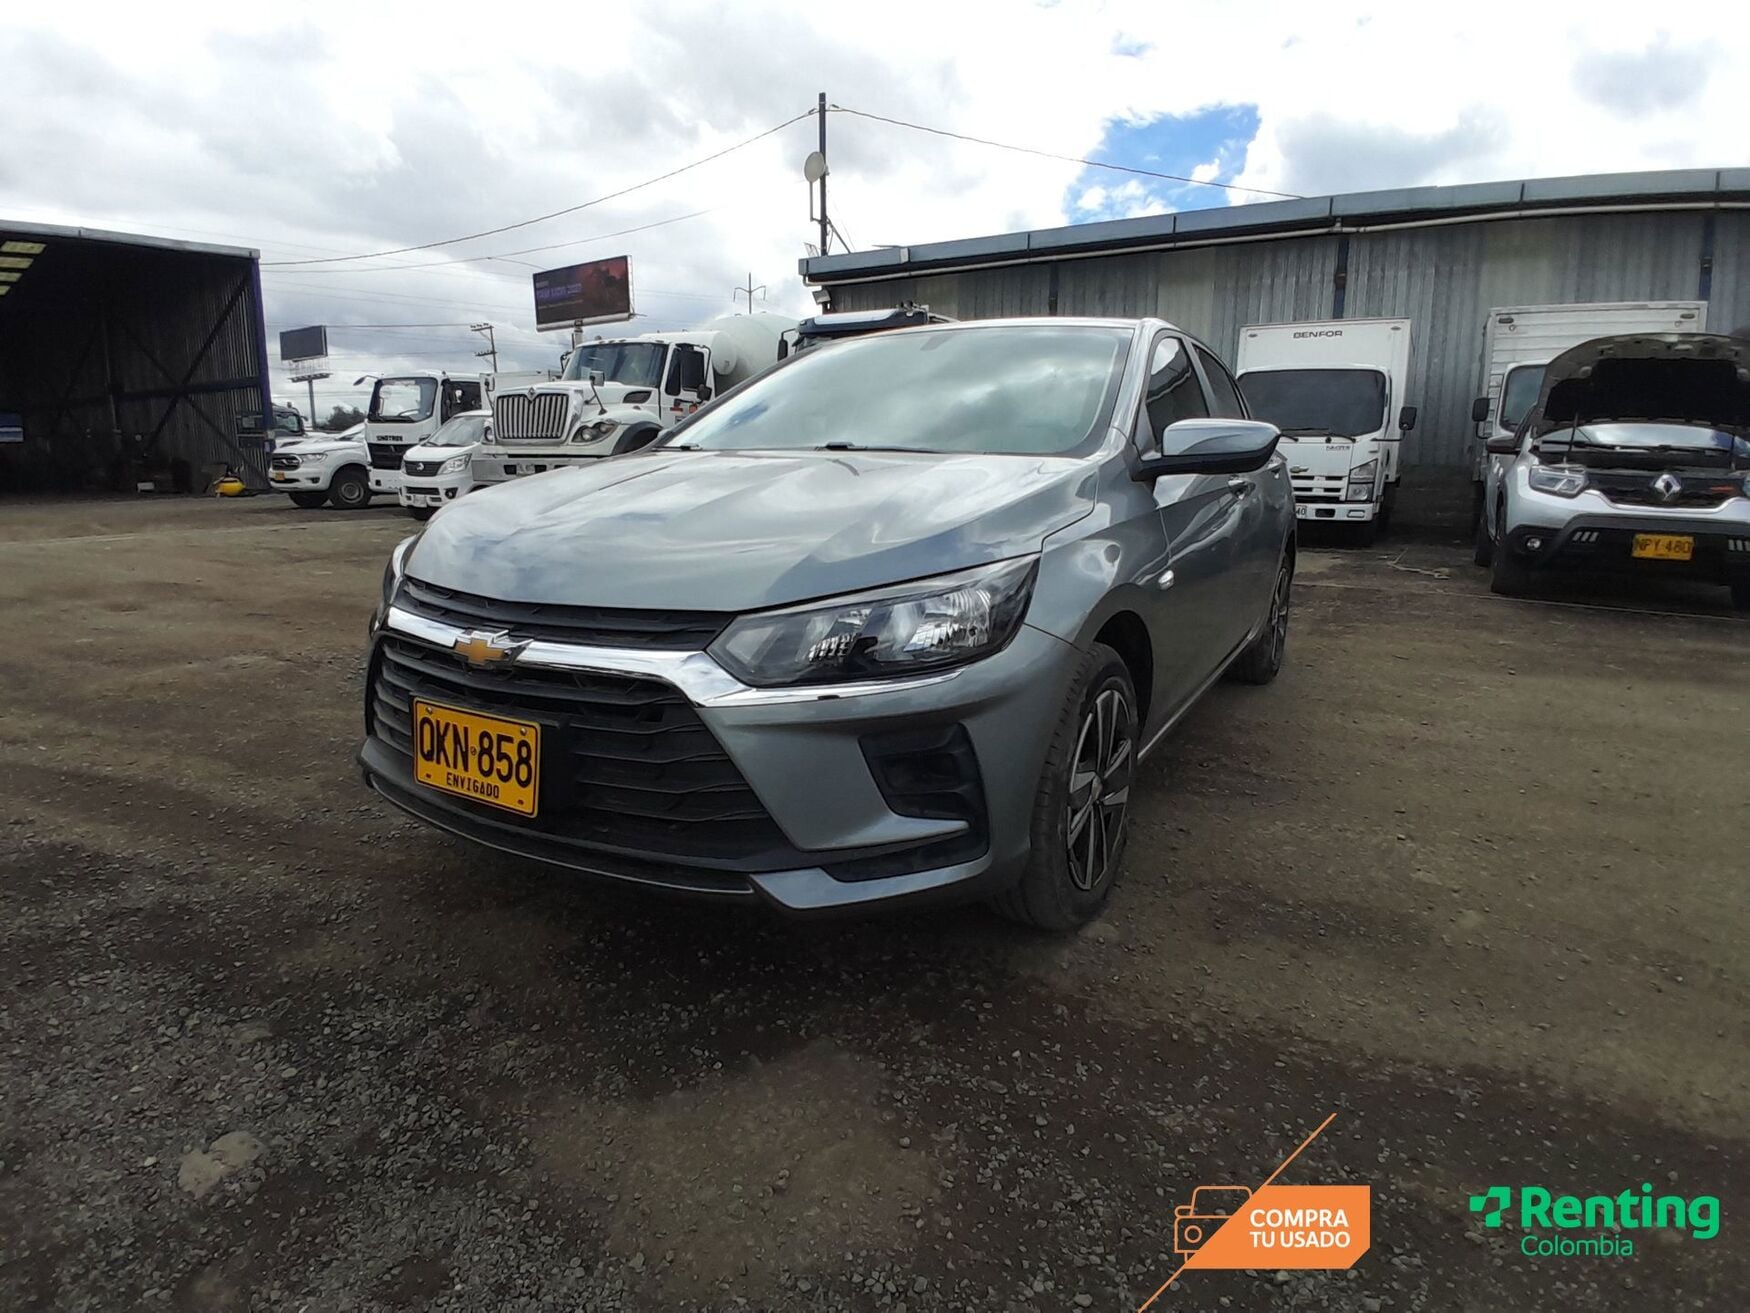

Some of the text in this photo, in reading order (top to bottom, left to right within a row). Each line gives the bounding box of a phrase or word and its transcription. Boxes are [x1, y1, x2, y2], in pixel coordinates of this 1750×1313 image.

[419, 716, 533, 788] QKN 858
[446, 772, 500, 799] ENVIGADO
